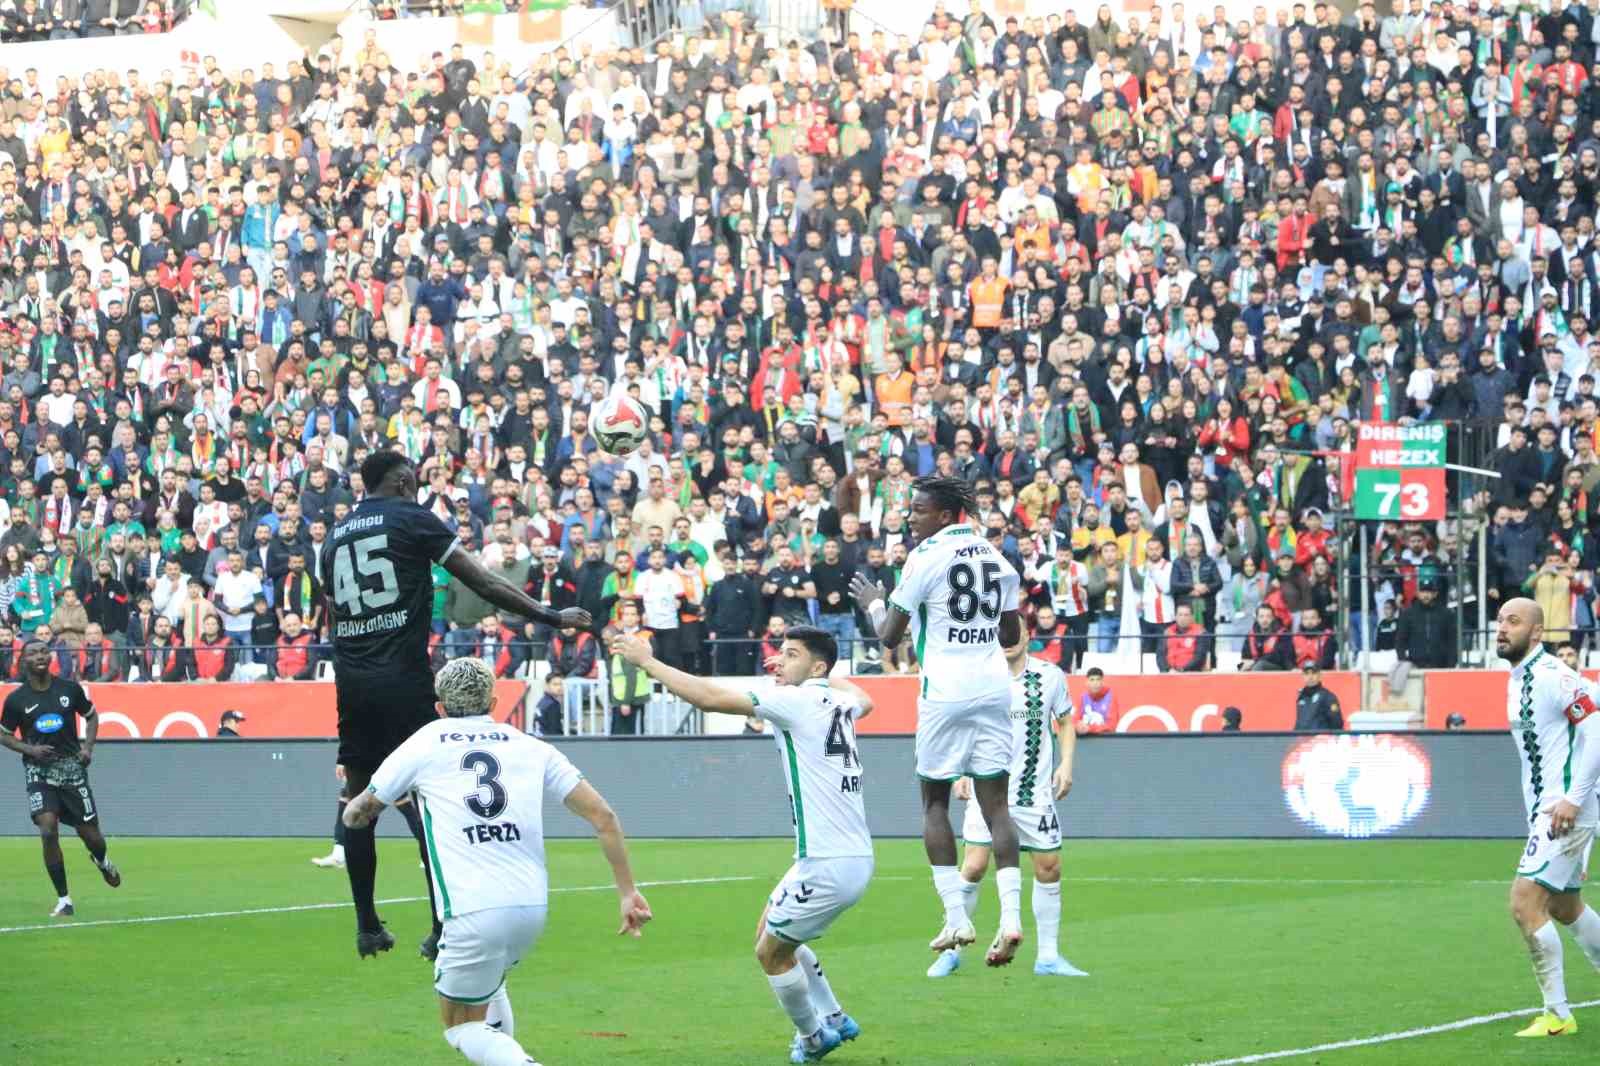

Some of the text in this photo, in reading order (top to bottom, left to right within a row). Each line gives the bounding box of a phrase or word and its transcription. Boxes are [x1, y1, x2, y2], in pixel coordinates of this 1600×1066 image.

[1371, 449, 1439, 465] HEZEX
[1374, 483, 1429, 516] 73
[333, 534, 400, 615] 45
[947, 560, 1001, 623] 85
[825, 705, 859, 768] 4
[460, 750, 508, 820] 3
[462, 823, 521, 844] TERZI
[1038, 813, 1059, 834] 44
